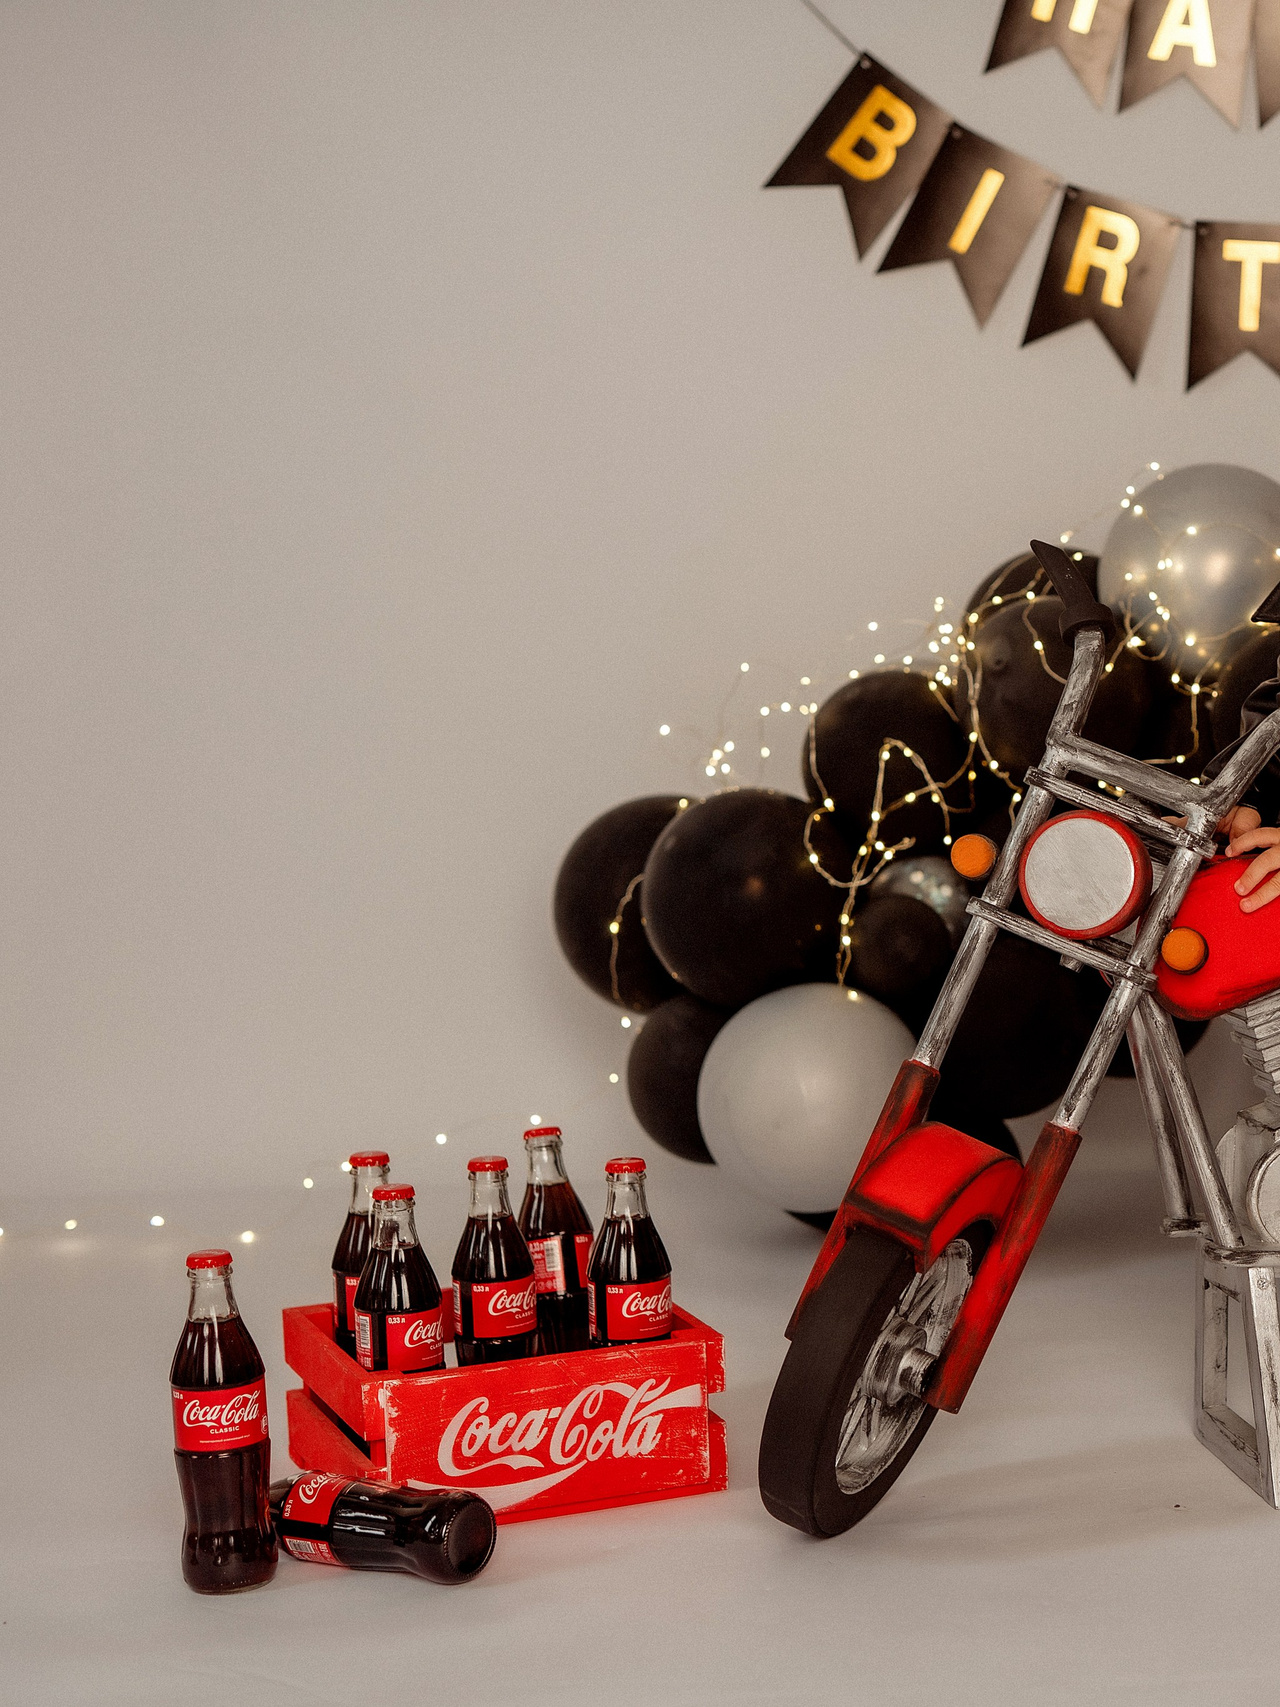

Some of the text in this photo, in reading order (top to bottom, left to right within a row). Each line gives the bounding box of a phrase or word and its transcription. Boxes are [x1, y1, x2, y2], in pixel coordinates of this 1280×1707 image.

[183, 1390, 261, 1428] Coca-Cola
[437, 1376, 671, 1477] Coca-Cola
[210, 1425, 240, 1435] CLASSIC
